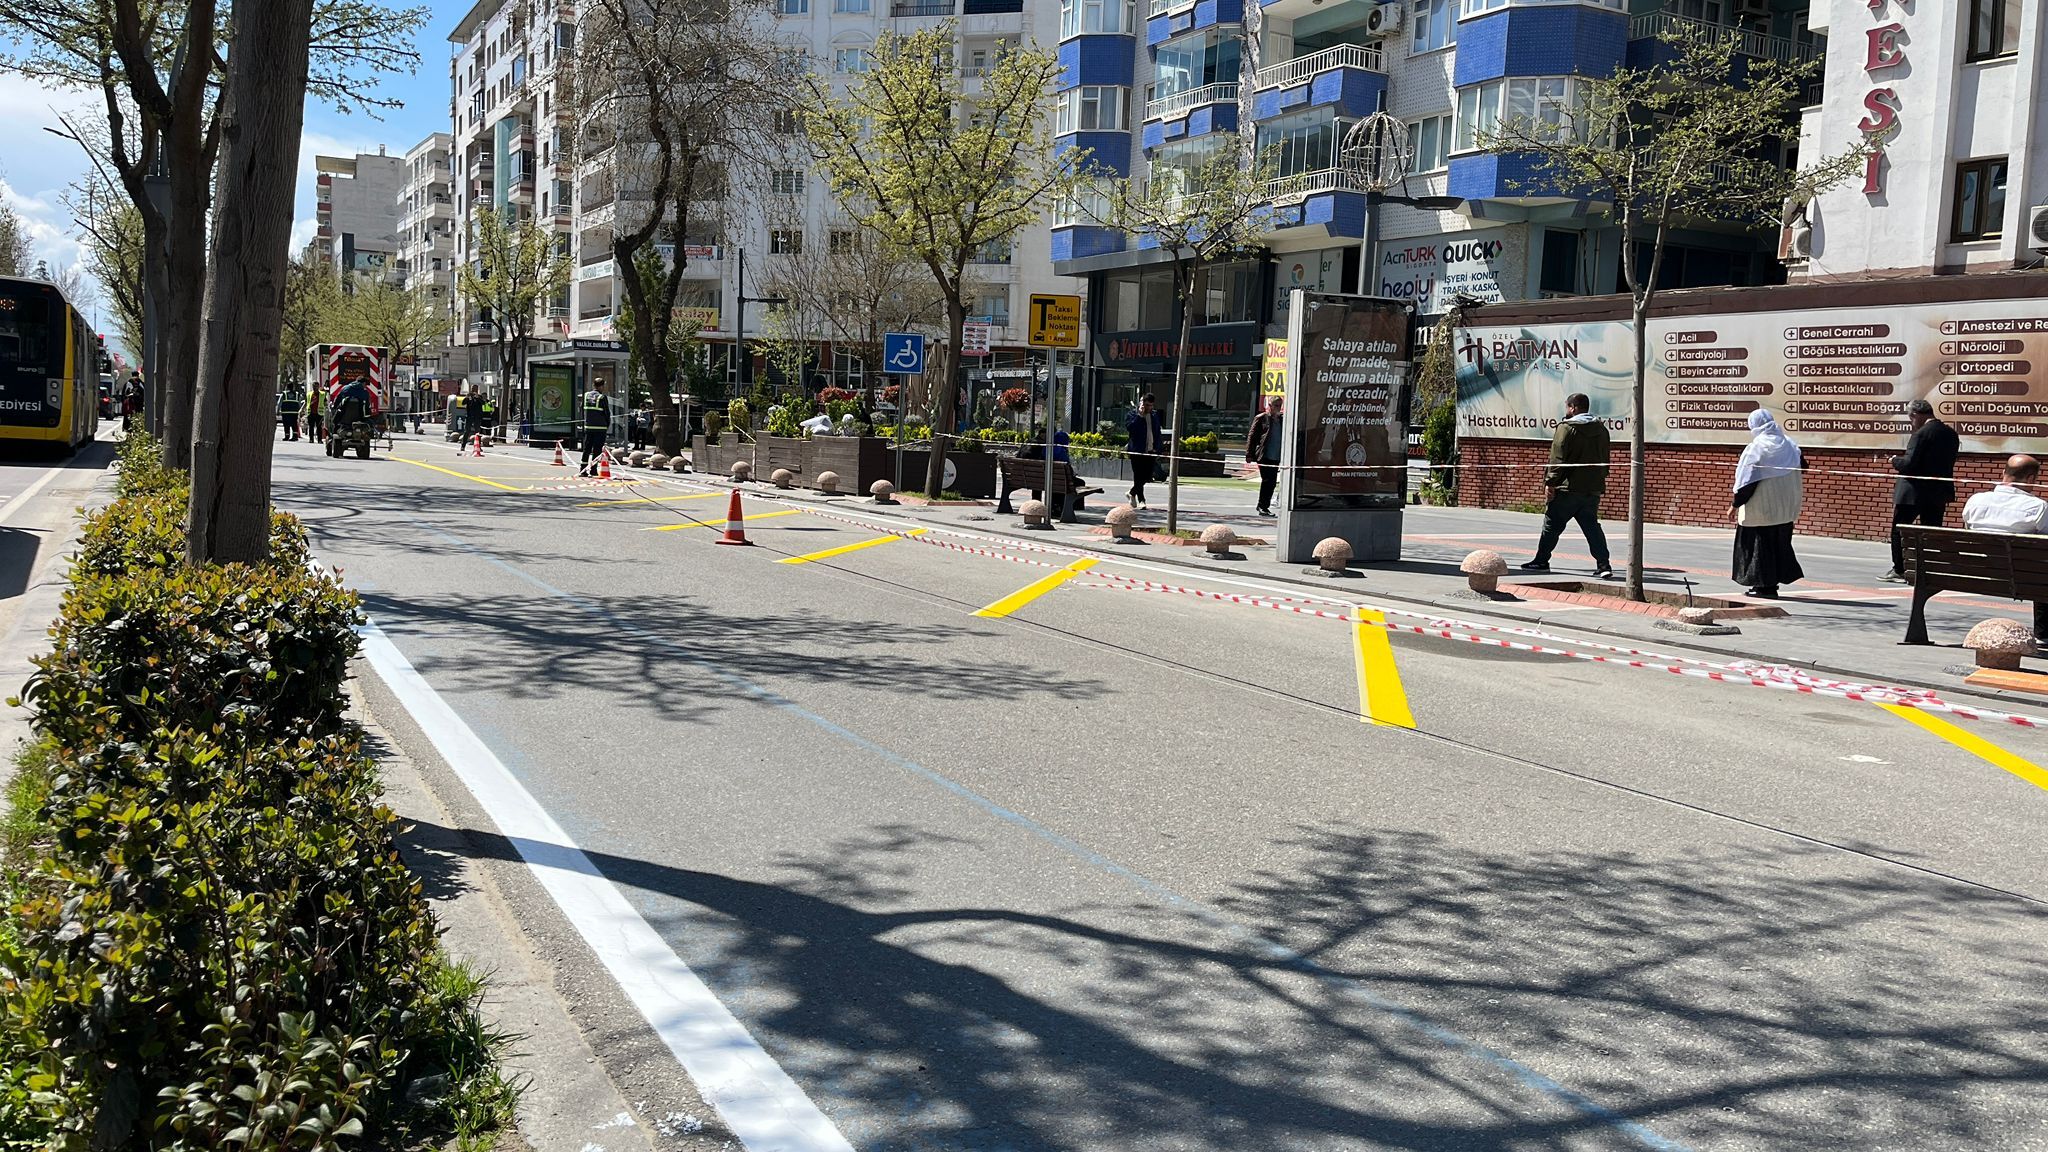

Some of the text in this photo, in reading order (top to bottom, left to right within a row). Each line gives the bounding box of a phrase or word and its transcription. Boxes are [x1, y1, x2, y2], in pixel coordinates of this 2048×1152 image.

[1857, 0, 1905, 193] ESİ
[1443, 240, 1495, 264] QUICK
[1472, 271, 1499, 281] KONUT
[1472, 282, 1499, 293] KASKO
[1033, 298, 1056, 330] T
[1962, 320, 2015, 331] Anestezi
[2018, 322, 2031, 330] ve
[1680, 334, 1697, 342] Acil
[1802, 327, 1874, 338] Genel Cerrahi
[1322, 337, 1397, 353] Sahaya atılan
[1493, 339, 1578, 360] BATMAN
[1961, 341, 2006, 353] Nöroloji
[1680, 350, 1727, 360] Kardiyoloji
[1802, 345, 1900, 357] Göğüs Hastalıkları
[1327, 354, 1390, 370] her madde,
[1493, 361, 1579, 371] HASTANESİ
[1680, 367, 1741, 377] Beyin Cerrahi
[1802, 365, 1885, 375] Göz Hastalıkları
[1961, 362, 2014, 374] Ortopedi
[1316, 370, 1400, 385] takımına atılan
[1327, 386, 1389, 399] bir cezadır.
[1681, 384, 1764, 394] Çocuk Hastalıkları
[1802, 382, 1874, 394] İç Hastalıkları
[1960, 382, 1997, 395] Üroloji
[0, 399, 41, 411] EDİYESİ
[1327, 403, 1387, 414] Coşku tribünde,
[1681, 402, 1734, 411] Fizik Tedavi
[1802, 402, 1830, 411] Kulak
[1833, 403, 1863, 411] Burun
[1866, 402, 1900, 413] Boğaz
[1961, 403, 1985, 412] Yeni
[1988, 403, 2030, 414] Doğum
[1321, 416, 1392, 426] sorumluluk sende!
[1541, 418, 1557, 428] ve
[1681, 419, 1729, 429] Enfeksiyon
[1802, 420, 1831, 429] Kadın
[1833, 421, 1856, 430] Has.
[1874, 421, 1913, 433] Doğum
[1961, 422, 2038, 434] Yoğun Bakım
